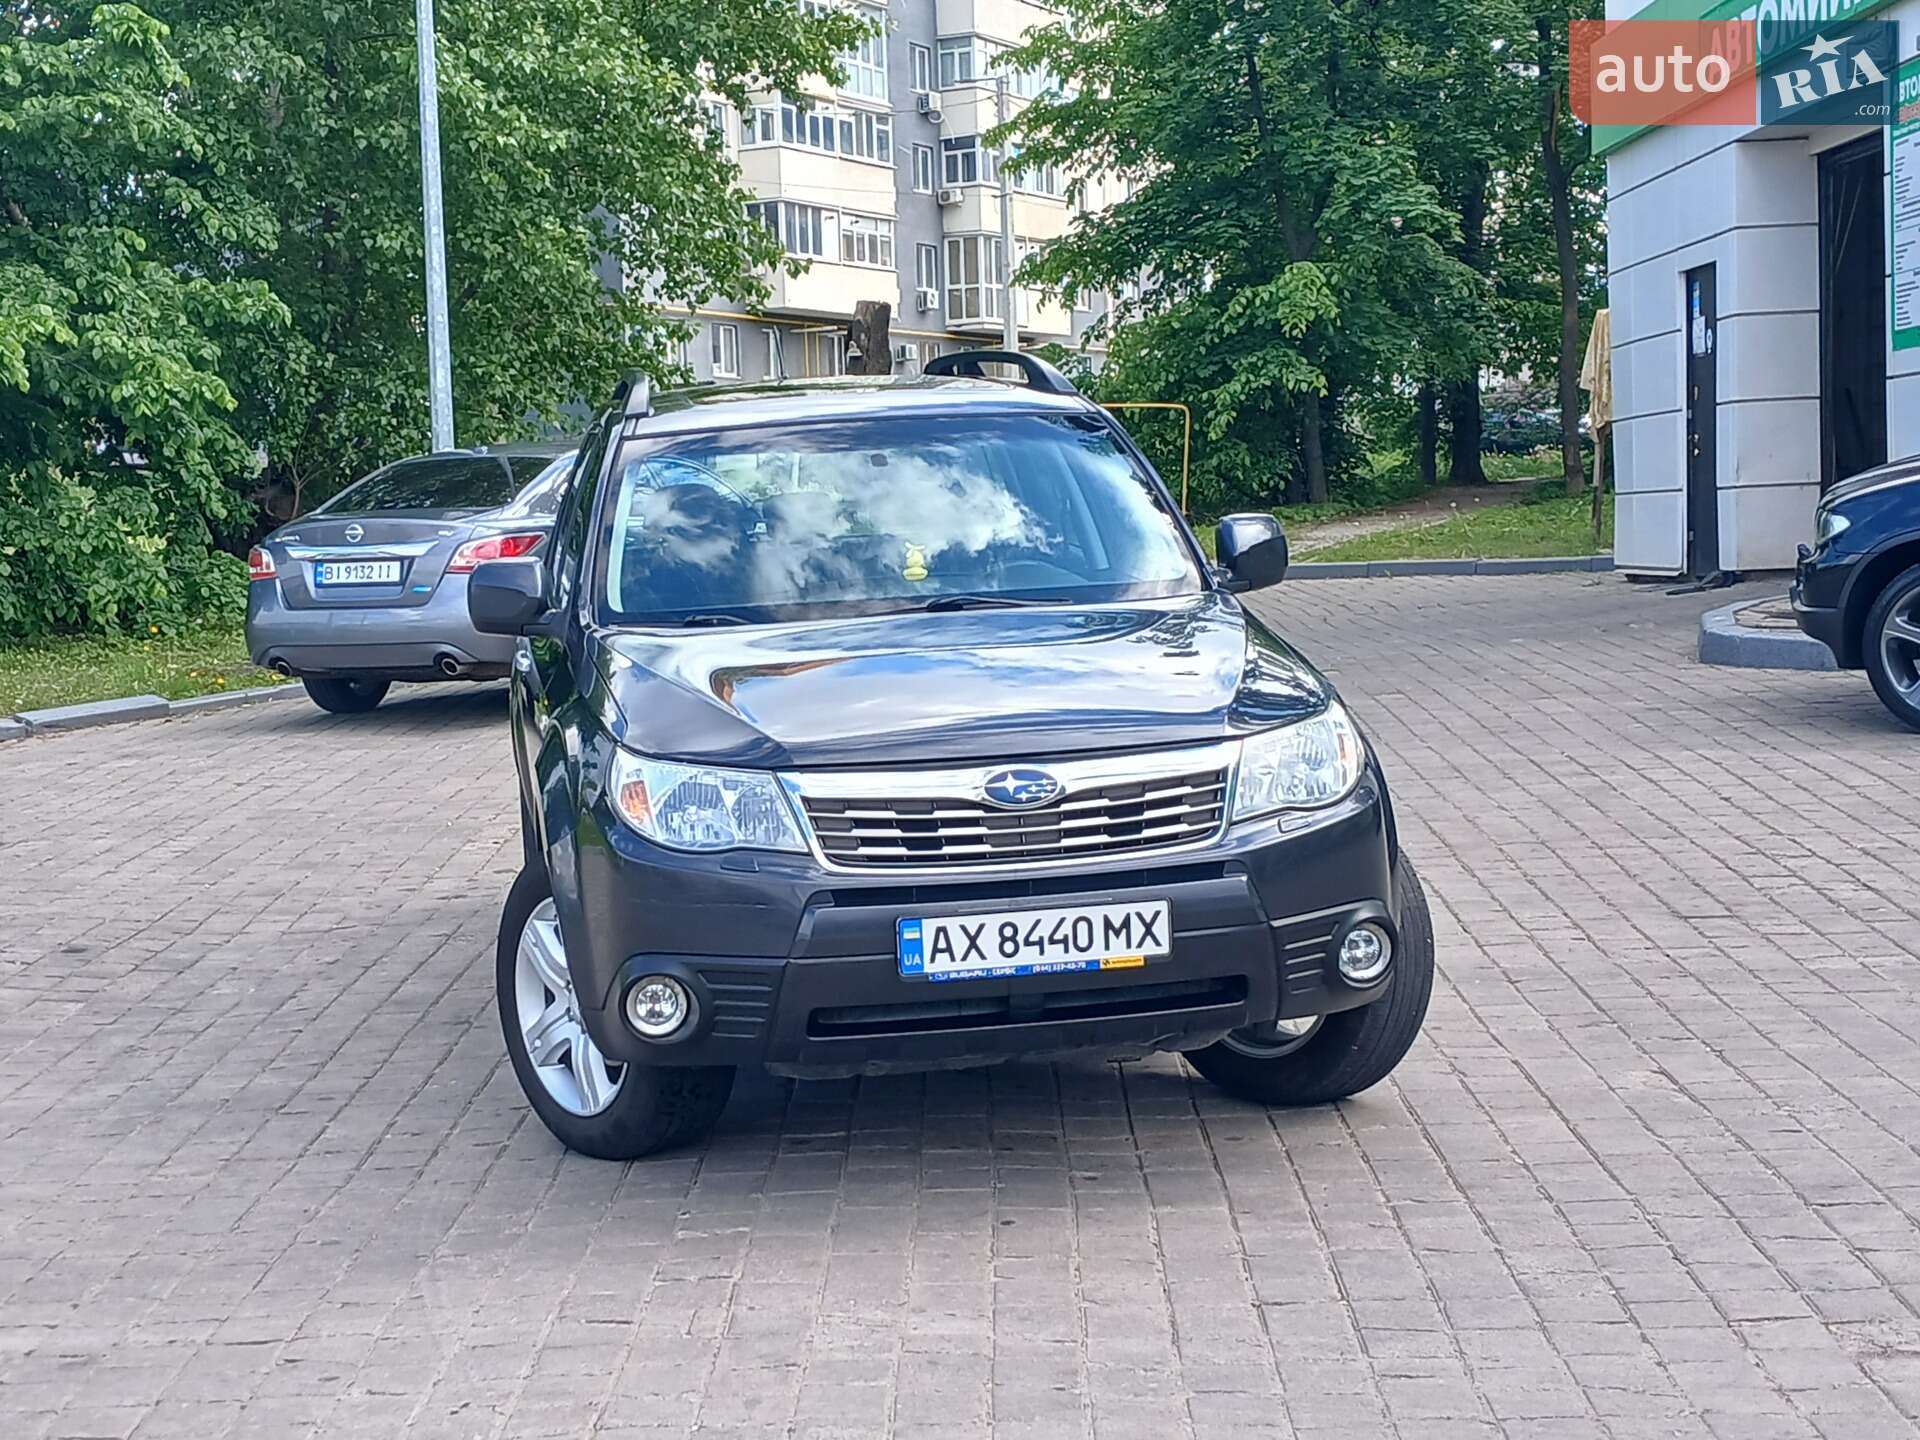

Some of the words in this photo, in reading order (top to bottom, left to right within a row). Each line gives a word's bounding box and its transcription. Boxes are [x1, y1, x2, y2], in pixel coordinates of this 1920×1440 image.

[324, 566, 341, 580] BI
[929, 921, 988, 964] AX
[998, 916, 1094, 958] 8440
[1103, 909, 1163, 951] MX
[903, 953, 922, 966] UA
